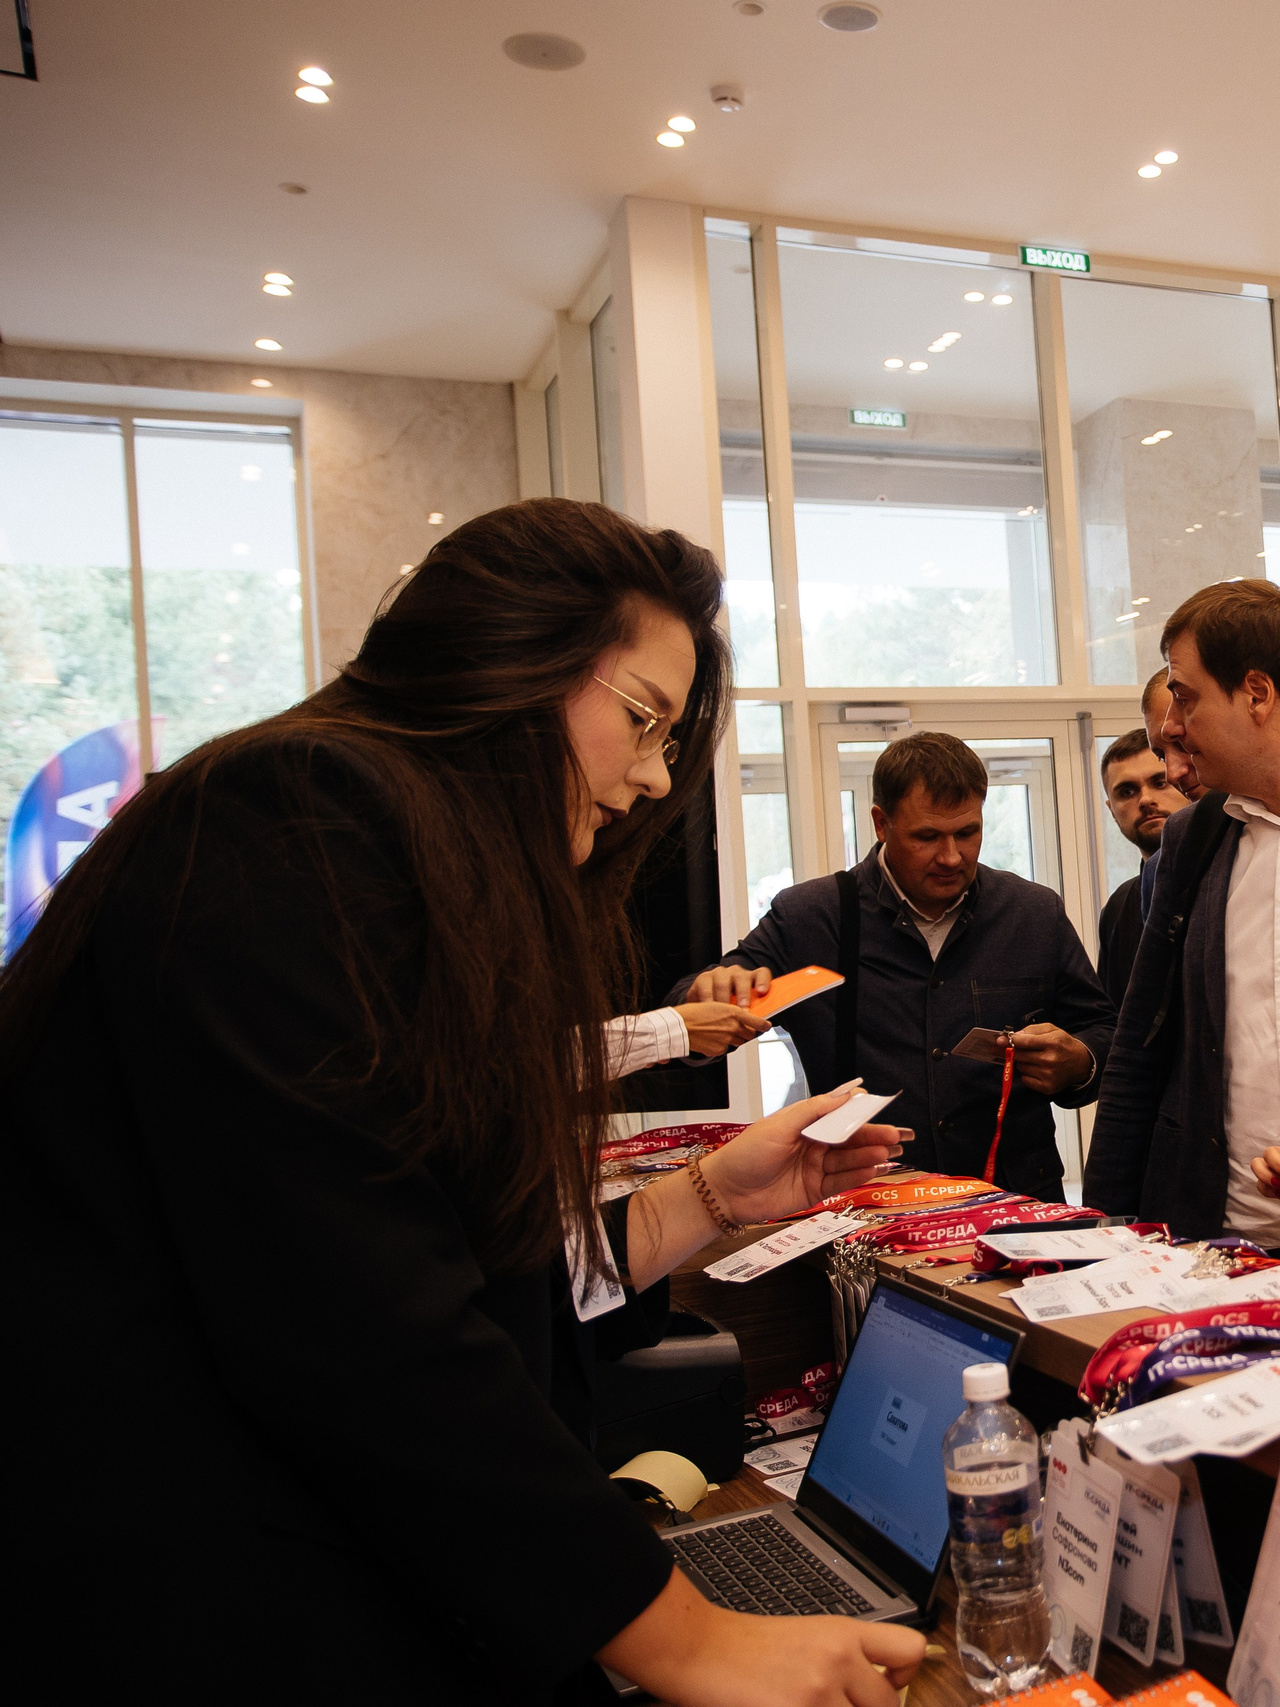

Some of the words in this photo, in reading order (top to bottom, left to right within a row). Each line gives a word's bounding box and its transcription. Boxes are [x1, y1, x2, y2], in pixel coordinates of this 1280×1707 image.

[1026, 248, 1087, 271] ВЫХОД
[854, 410, 903, 427] ВЫХОД
[871, 1190, 899, 1201] OCS
[914, 1184, 975, 1198] IT-СРЕДА
[908, 1223, 977, 1241] IT-СРЕДА
[1210, 1312, 1249, 1326] OCS
[1148, 1353, 1248, 1381] IT-СРЕДА
[1056, 1511, 1098, 1552] Екатерина
[1051, 1527, 1098, 1572] Сафронова
[1057, 1555, 1086, 1586] N3com
